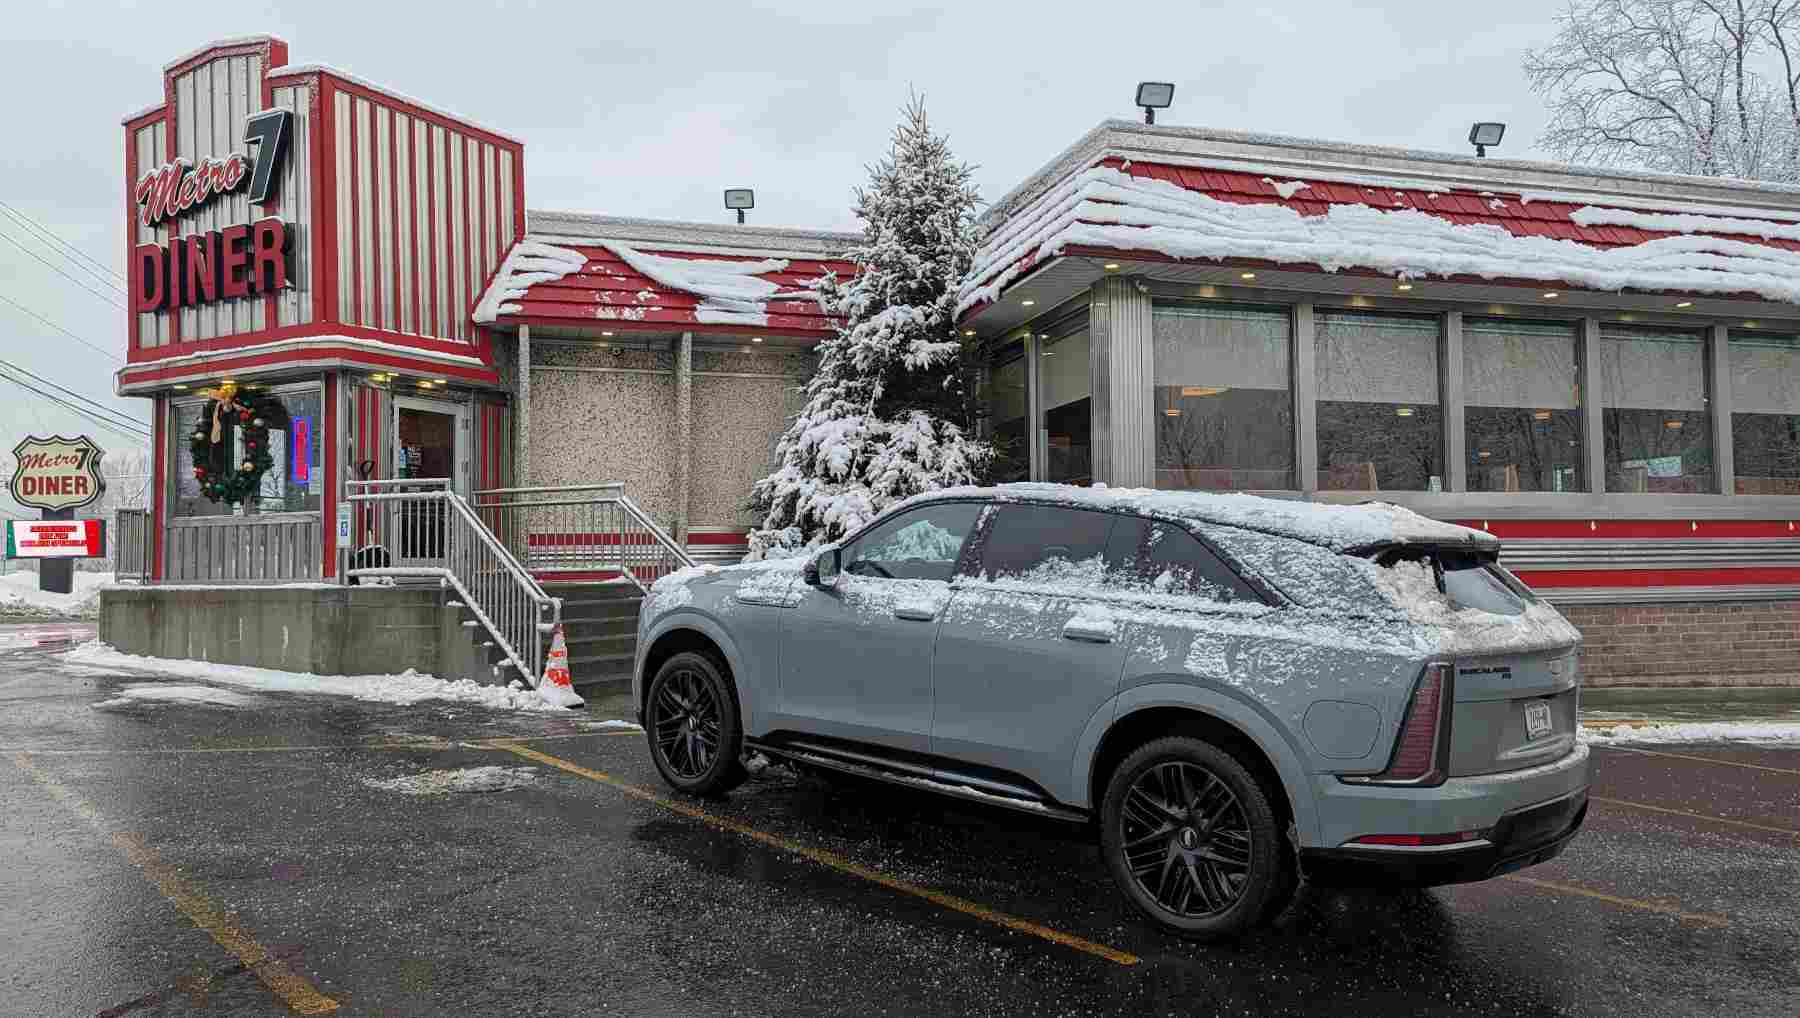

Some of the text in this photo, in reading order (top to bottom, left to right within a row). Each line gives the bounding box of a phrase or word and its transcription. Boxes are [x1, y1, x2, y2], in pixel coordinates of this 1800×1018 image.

[135, 109, 289, 225] Metro 7
[135, 217, 286, 313] DINER
[21, 447, 90, 470] Metro 7
[22, 476, 88, 496] DINER
